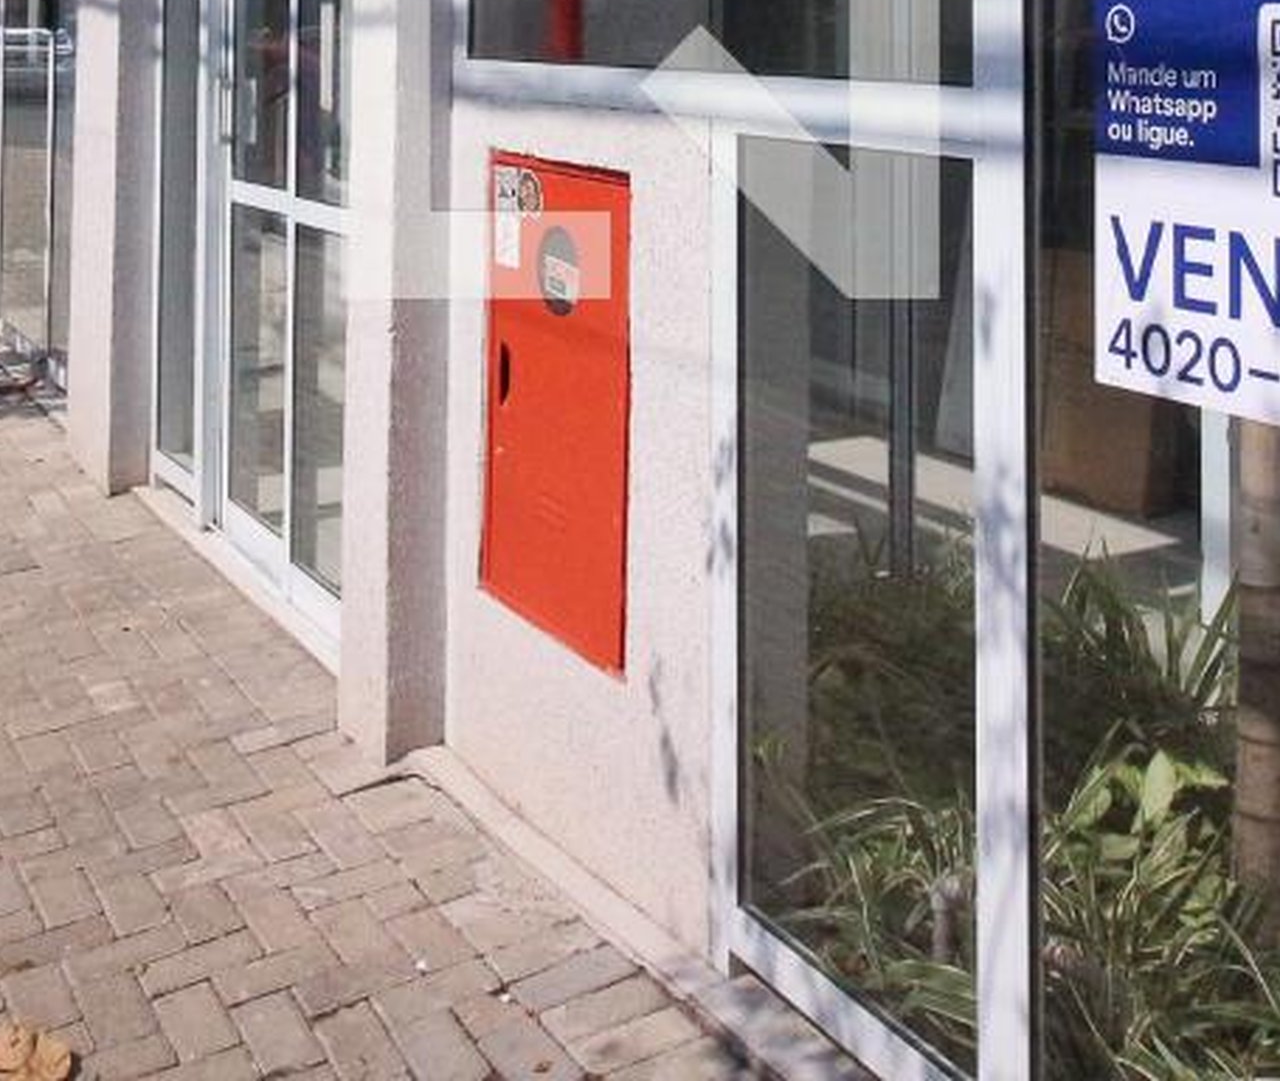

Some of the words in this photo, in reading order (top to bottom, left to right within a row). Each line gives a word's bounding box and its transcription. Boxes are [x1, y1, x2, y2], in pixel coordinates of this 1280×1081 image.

[1107, 61, 1177, 87] Mande
[1181, 69, 1216, 89] um
[1107, 88, 1217, 124] Whatsapp
[1107, 123, 1133, 141] ou
[1137, 118, 1195, 151] ligue.
